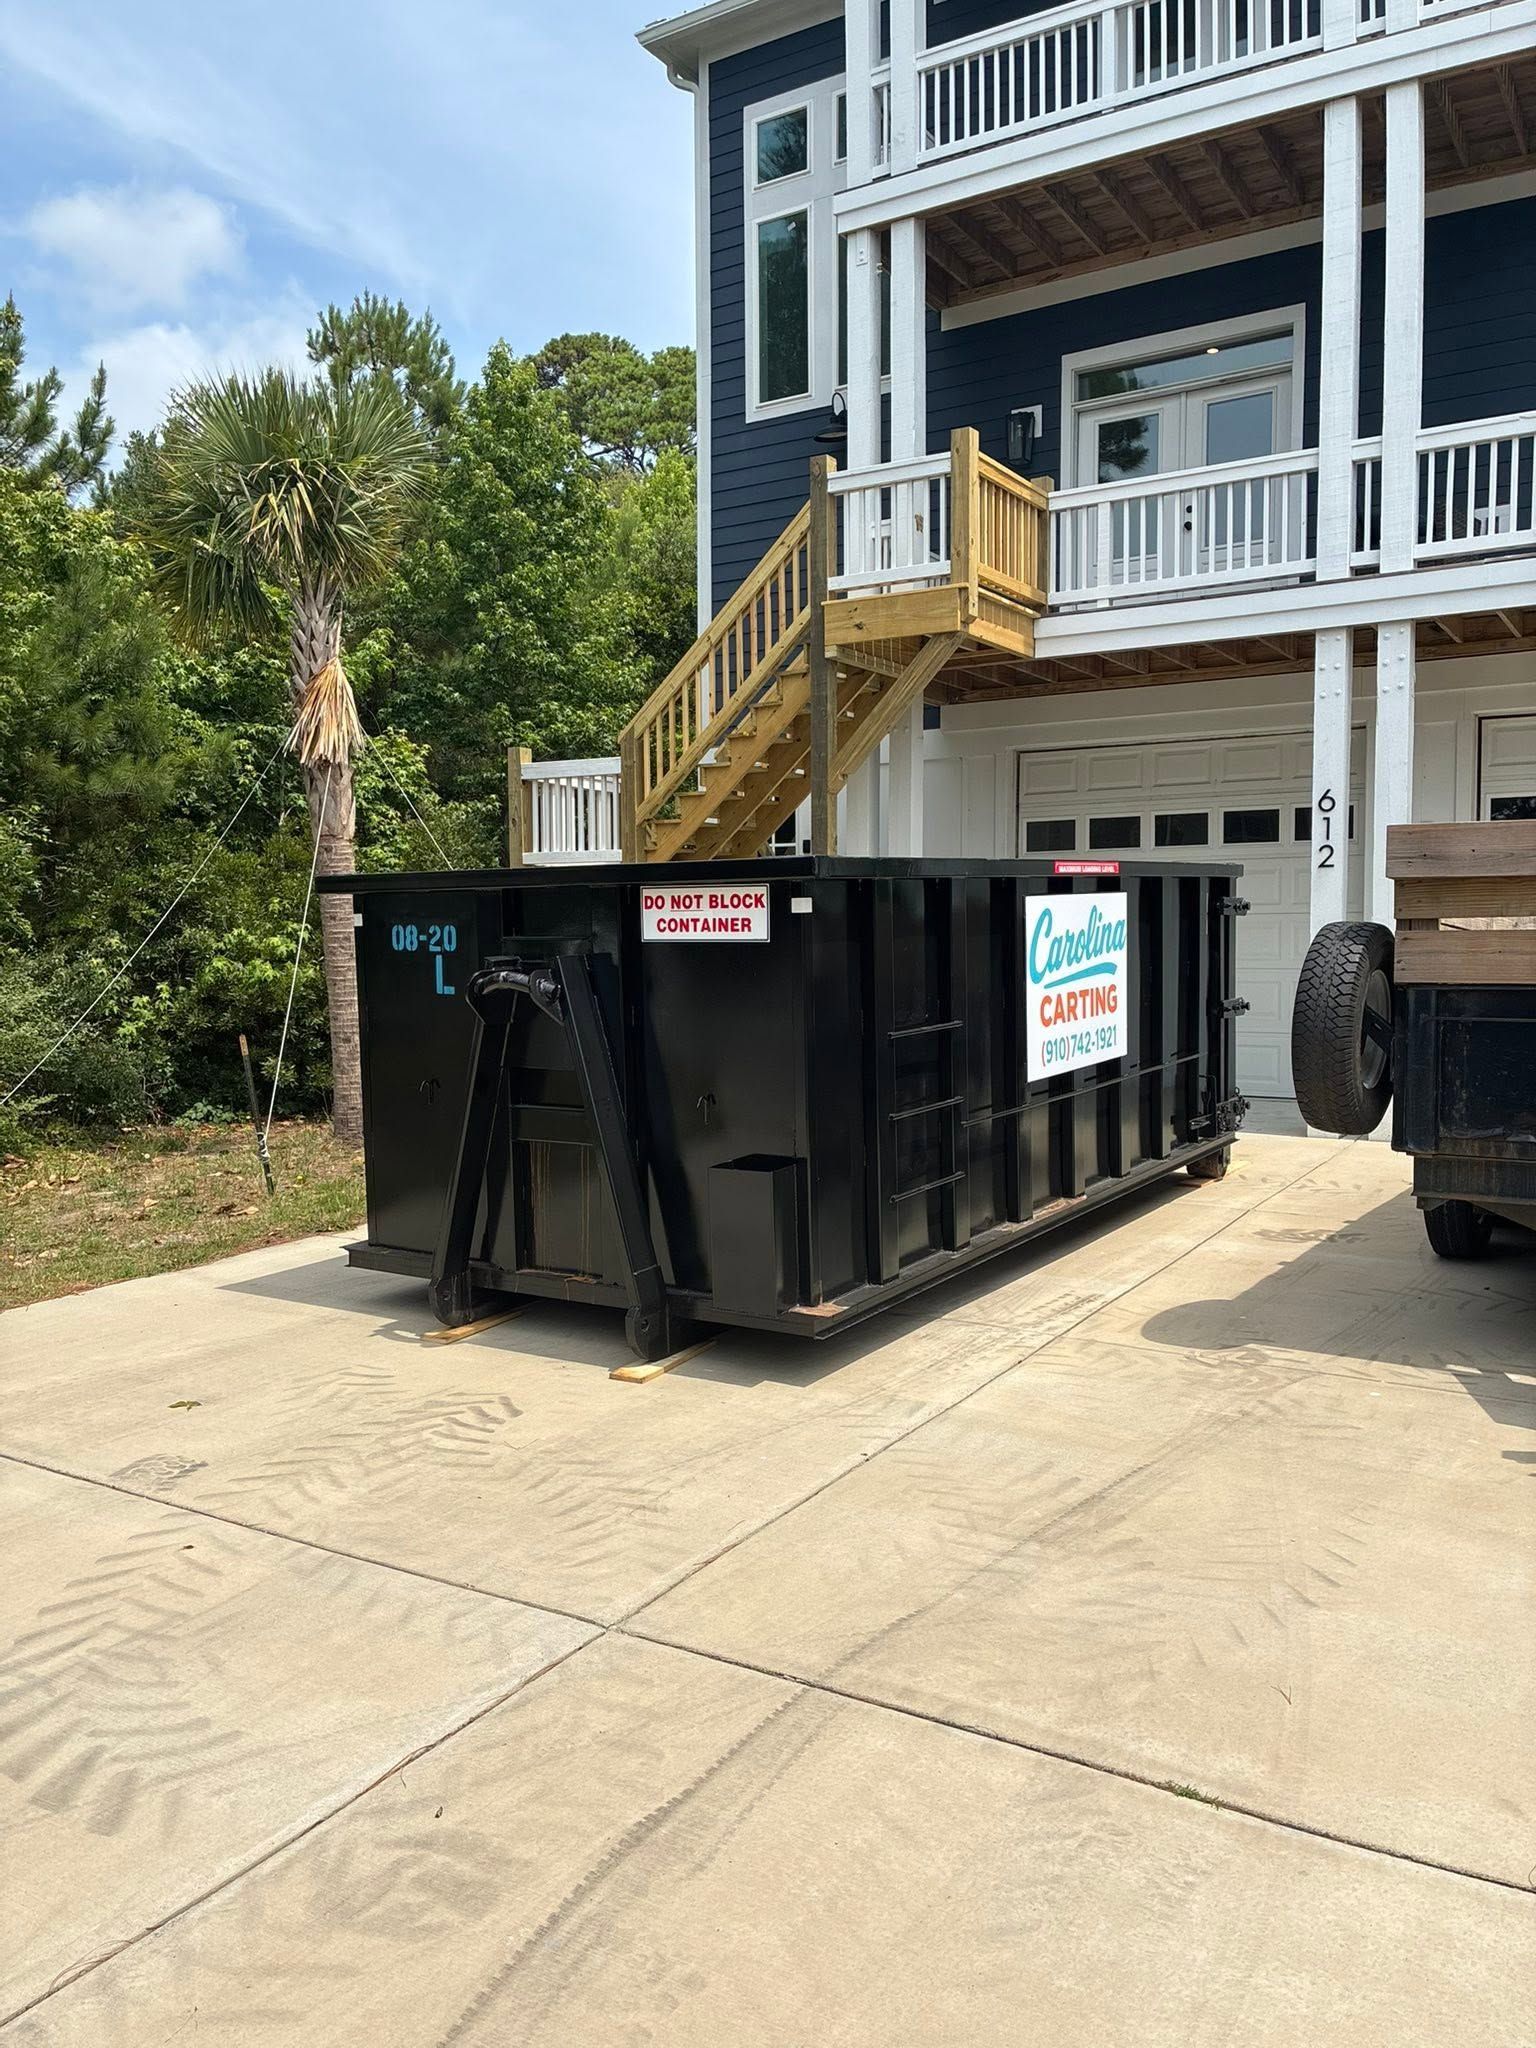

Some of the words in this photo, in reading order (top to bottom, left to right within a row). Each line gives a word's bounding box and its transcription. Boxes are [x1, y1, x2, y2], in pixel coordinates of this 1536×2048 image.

[1318, 789, 1336, 868] 612
[644, 895, 665, 910] DO
[670, 895, 703, 910] NOT
[708, 893, 765, 909] BLOCK
[392, 924, 457, 952] 08-20
[657, 917, 752, 933] CONTAINER
[1029, 905, 1126, 985] Carolina
[435, 954, 455, 995] L
[1040, 984, 1118, 1028] CARTING
[1041, 1024, 1117, 1067] (910)742-1921
